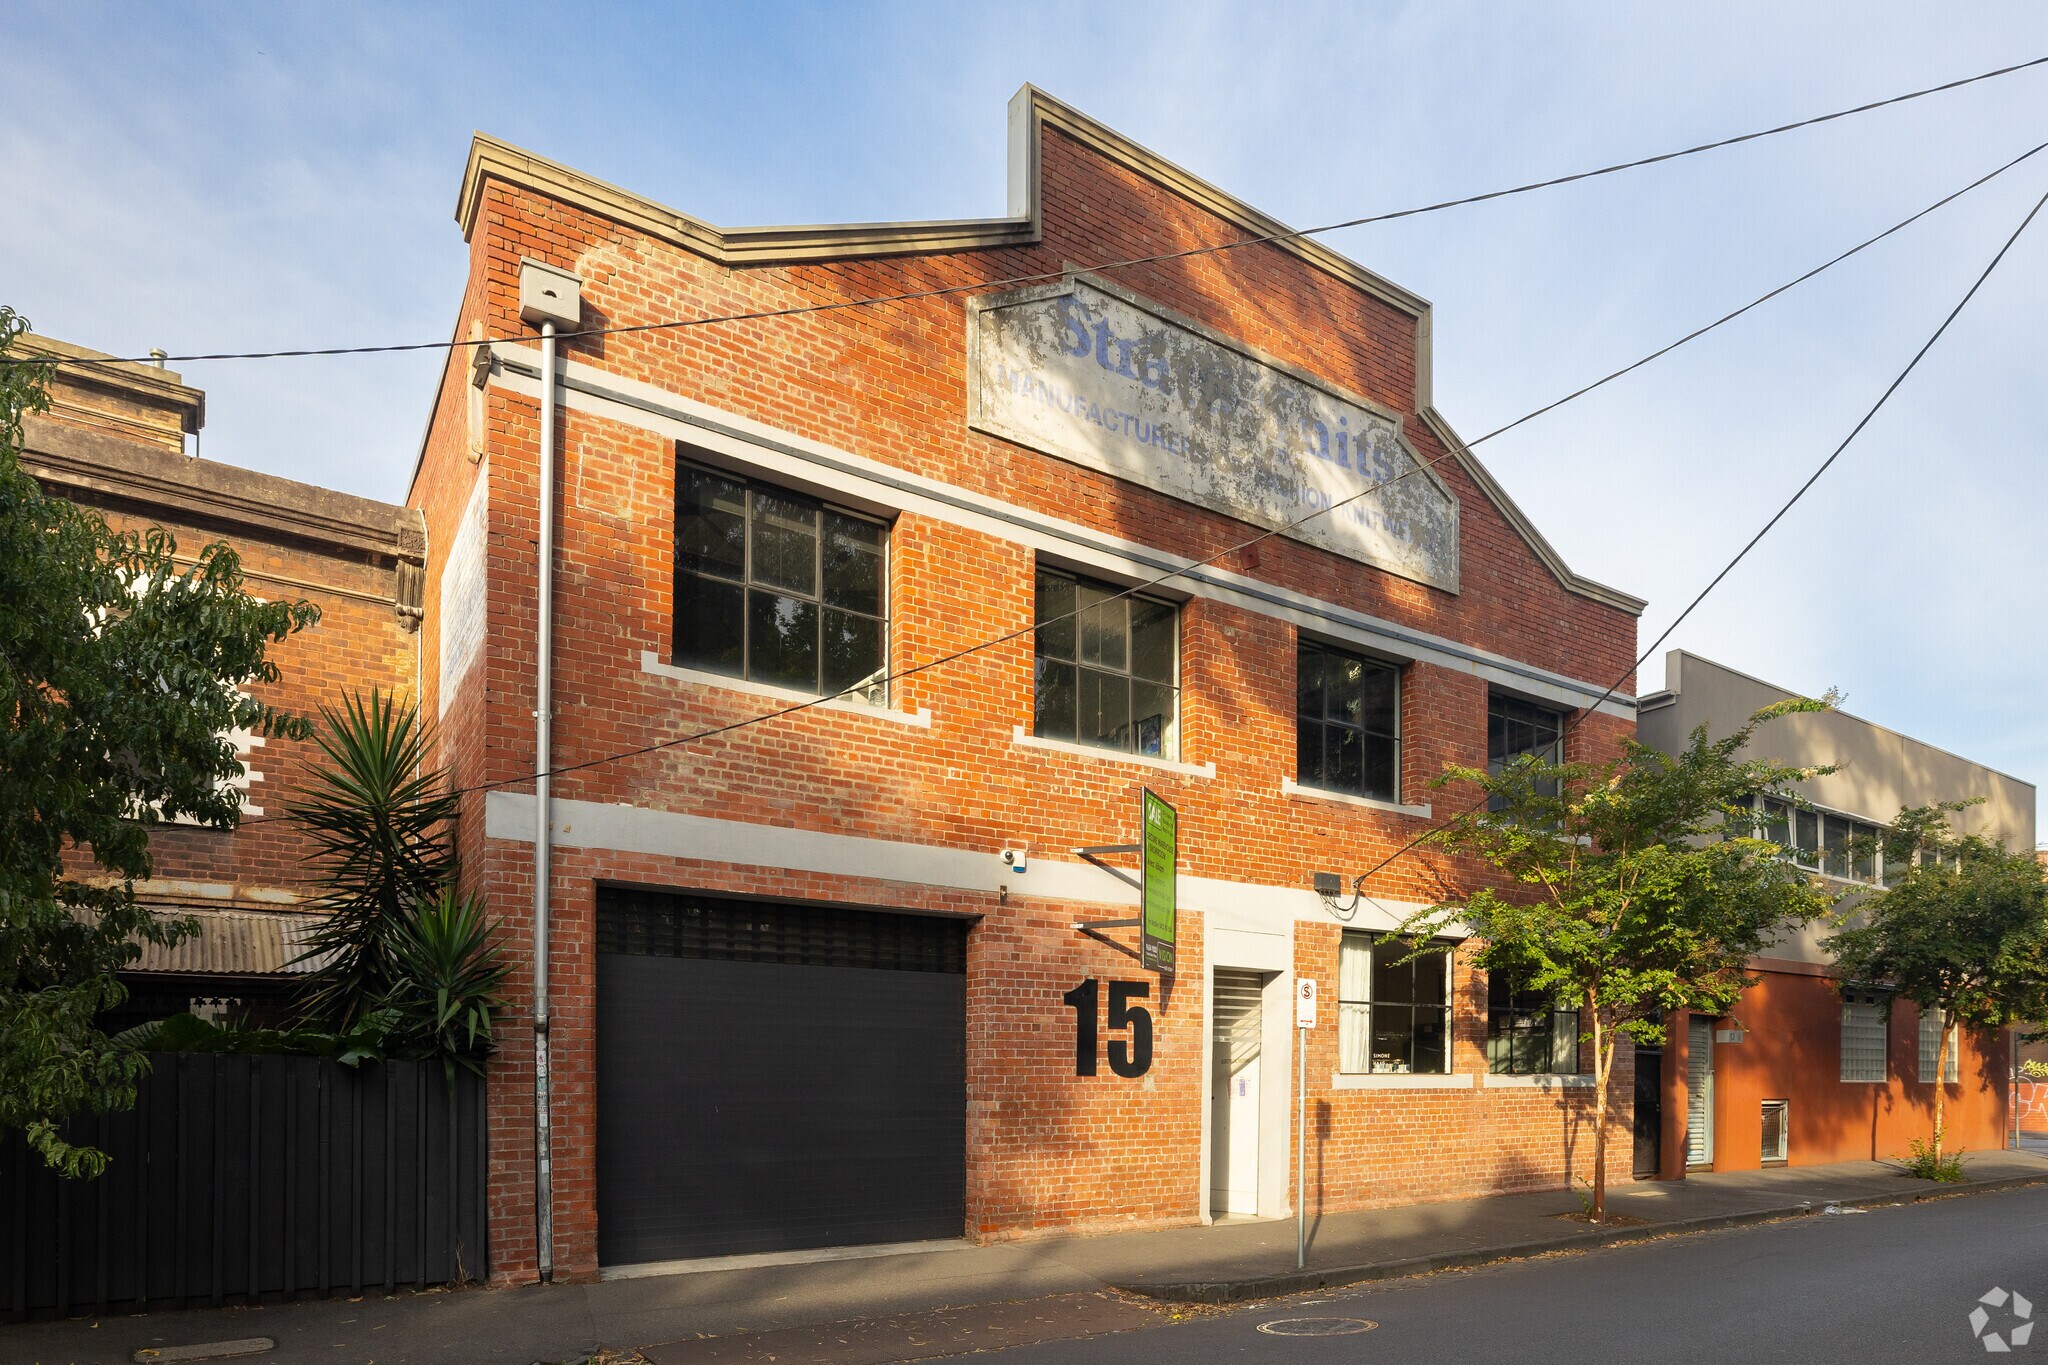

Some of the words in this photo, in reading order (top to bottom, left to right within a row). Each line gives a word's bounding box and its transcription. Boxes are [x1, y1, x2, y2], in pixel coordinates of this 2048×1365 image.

[1057, 293, 1234, 420] Stra
[1148, 803, 1161, 826] SALE
[1064, 979, 1153, 1078] 15
